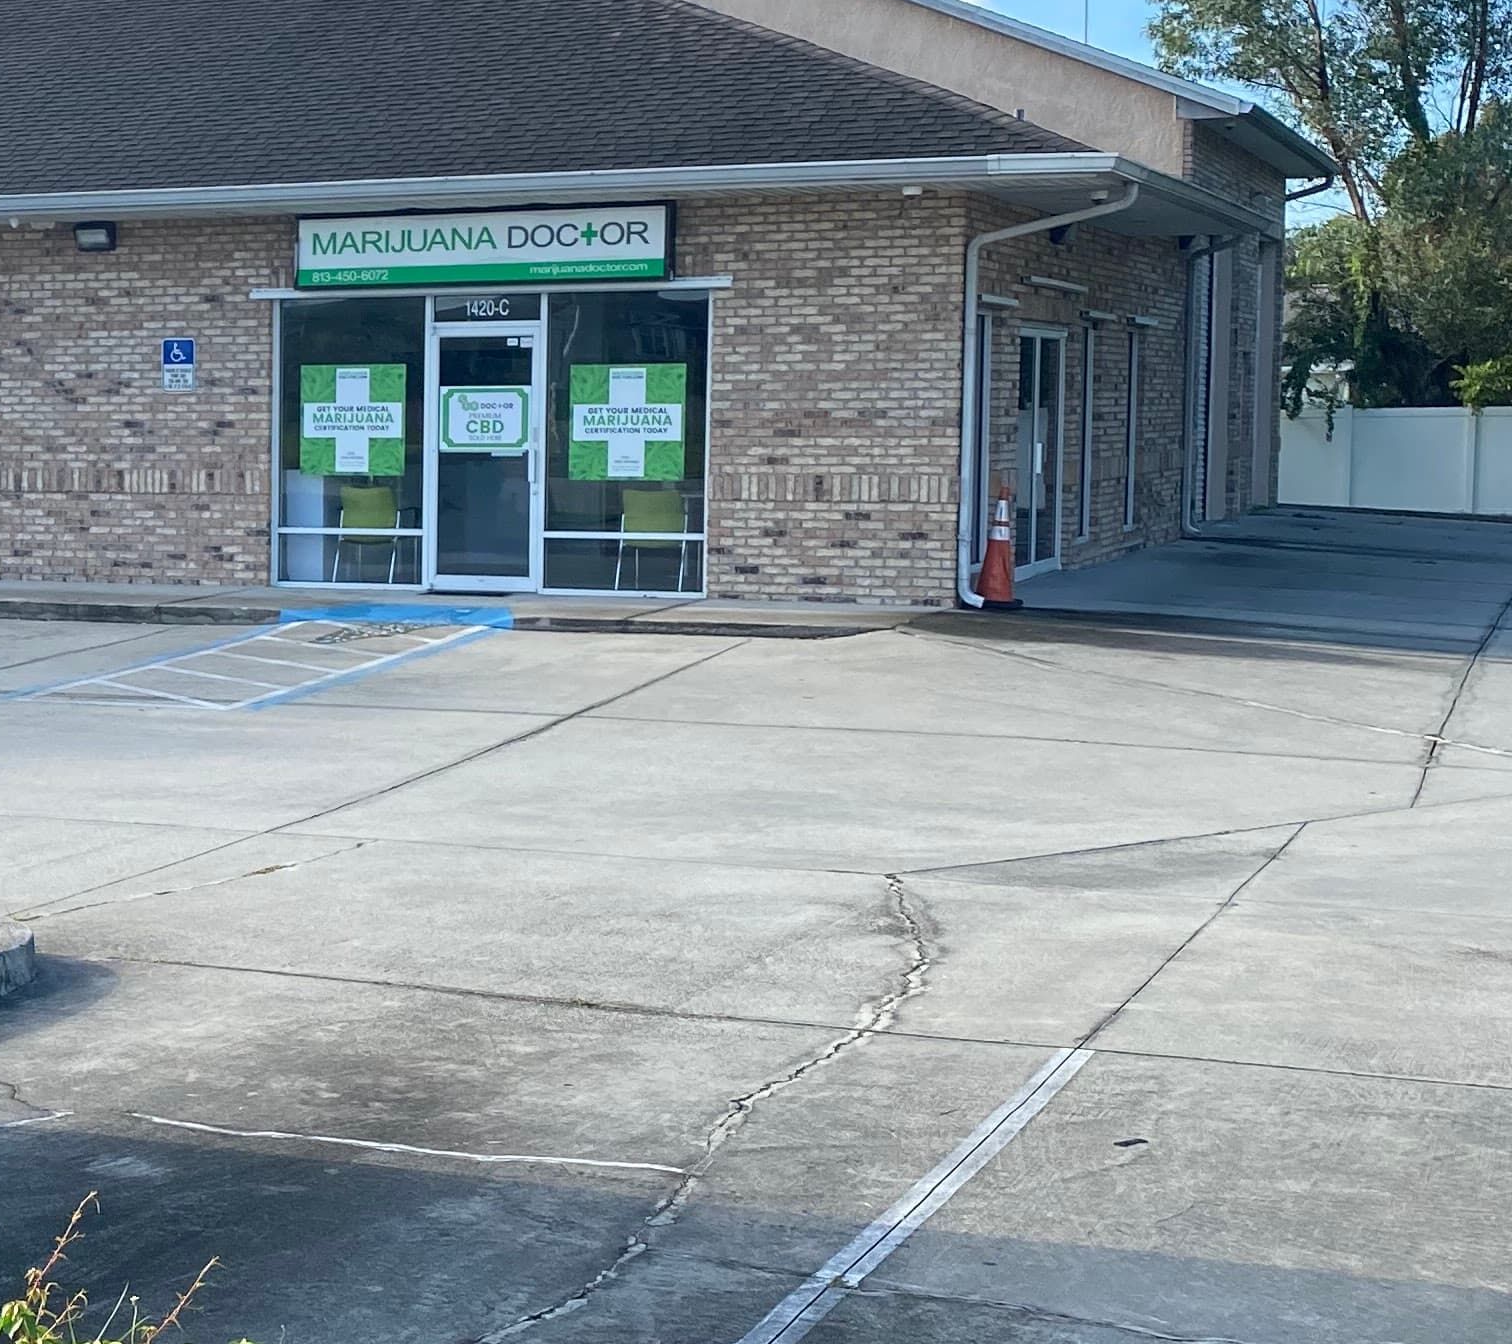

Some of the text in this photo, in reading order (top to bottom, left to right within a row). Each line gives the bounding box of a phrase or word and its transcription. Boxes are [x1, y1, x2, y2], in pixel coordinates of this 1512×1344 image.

[311, 226, 497, 256] MARIJUANA
[311, 269, 389, 283] 813-450-6072
[465, 298, 510, 316] 1420-C
[356, 405, 389, 413] MEDICAL
[587, 407, 604, 415] GET
[312, 413, 394, 424] MARIJUANA
[583, 415, 673, 426] MARIJUANA
[466, 419, 504, 434] CBD
